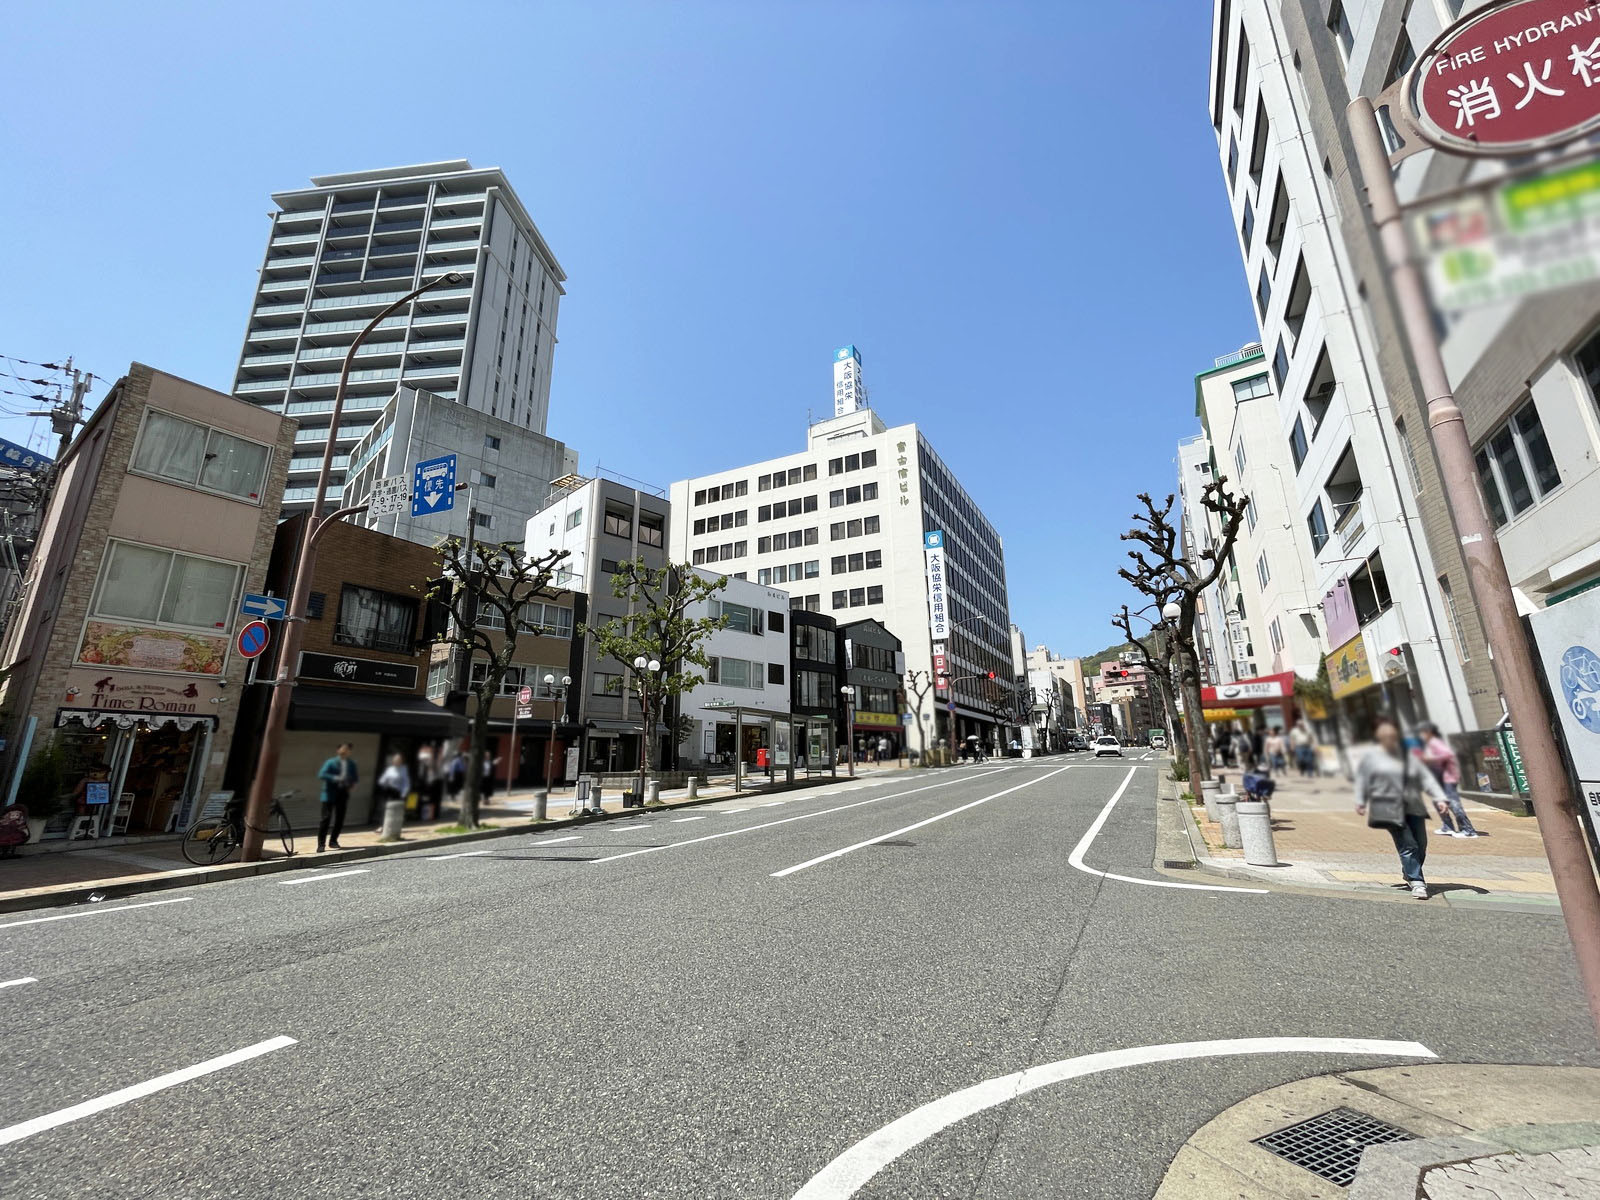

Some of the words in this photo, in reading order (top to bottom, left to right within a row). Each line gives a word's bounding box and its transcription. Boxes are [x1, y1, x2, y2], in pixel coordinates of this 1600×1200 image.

[1435, 46, 1486, 75] FIRE
[1493, 5, 1600, 55] HYDRANT
[1446, 37, 1600, 130] 消火栓
[843, 361, 853, 401] 大阪協栄
[425, 479, 444, 492] 優先
[373, 501, 404, 515] ここから
[930, 553, 946, 635] 大阪協栄信用組合
[91, 693, 135, 709] Time
[139, 696, 196, 713] Roman
